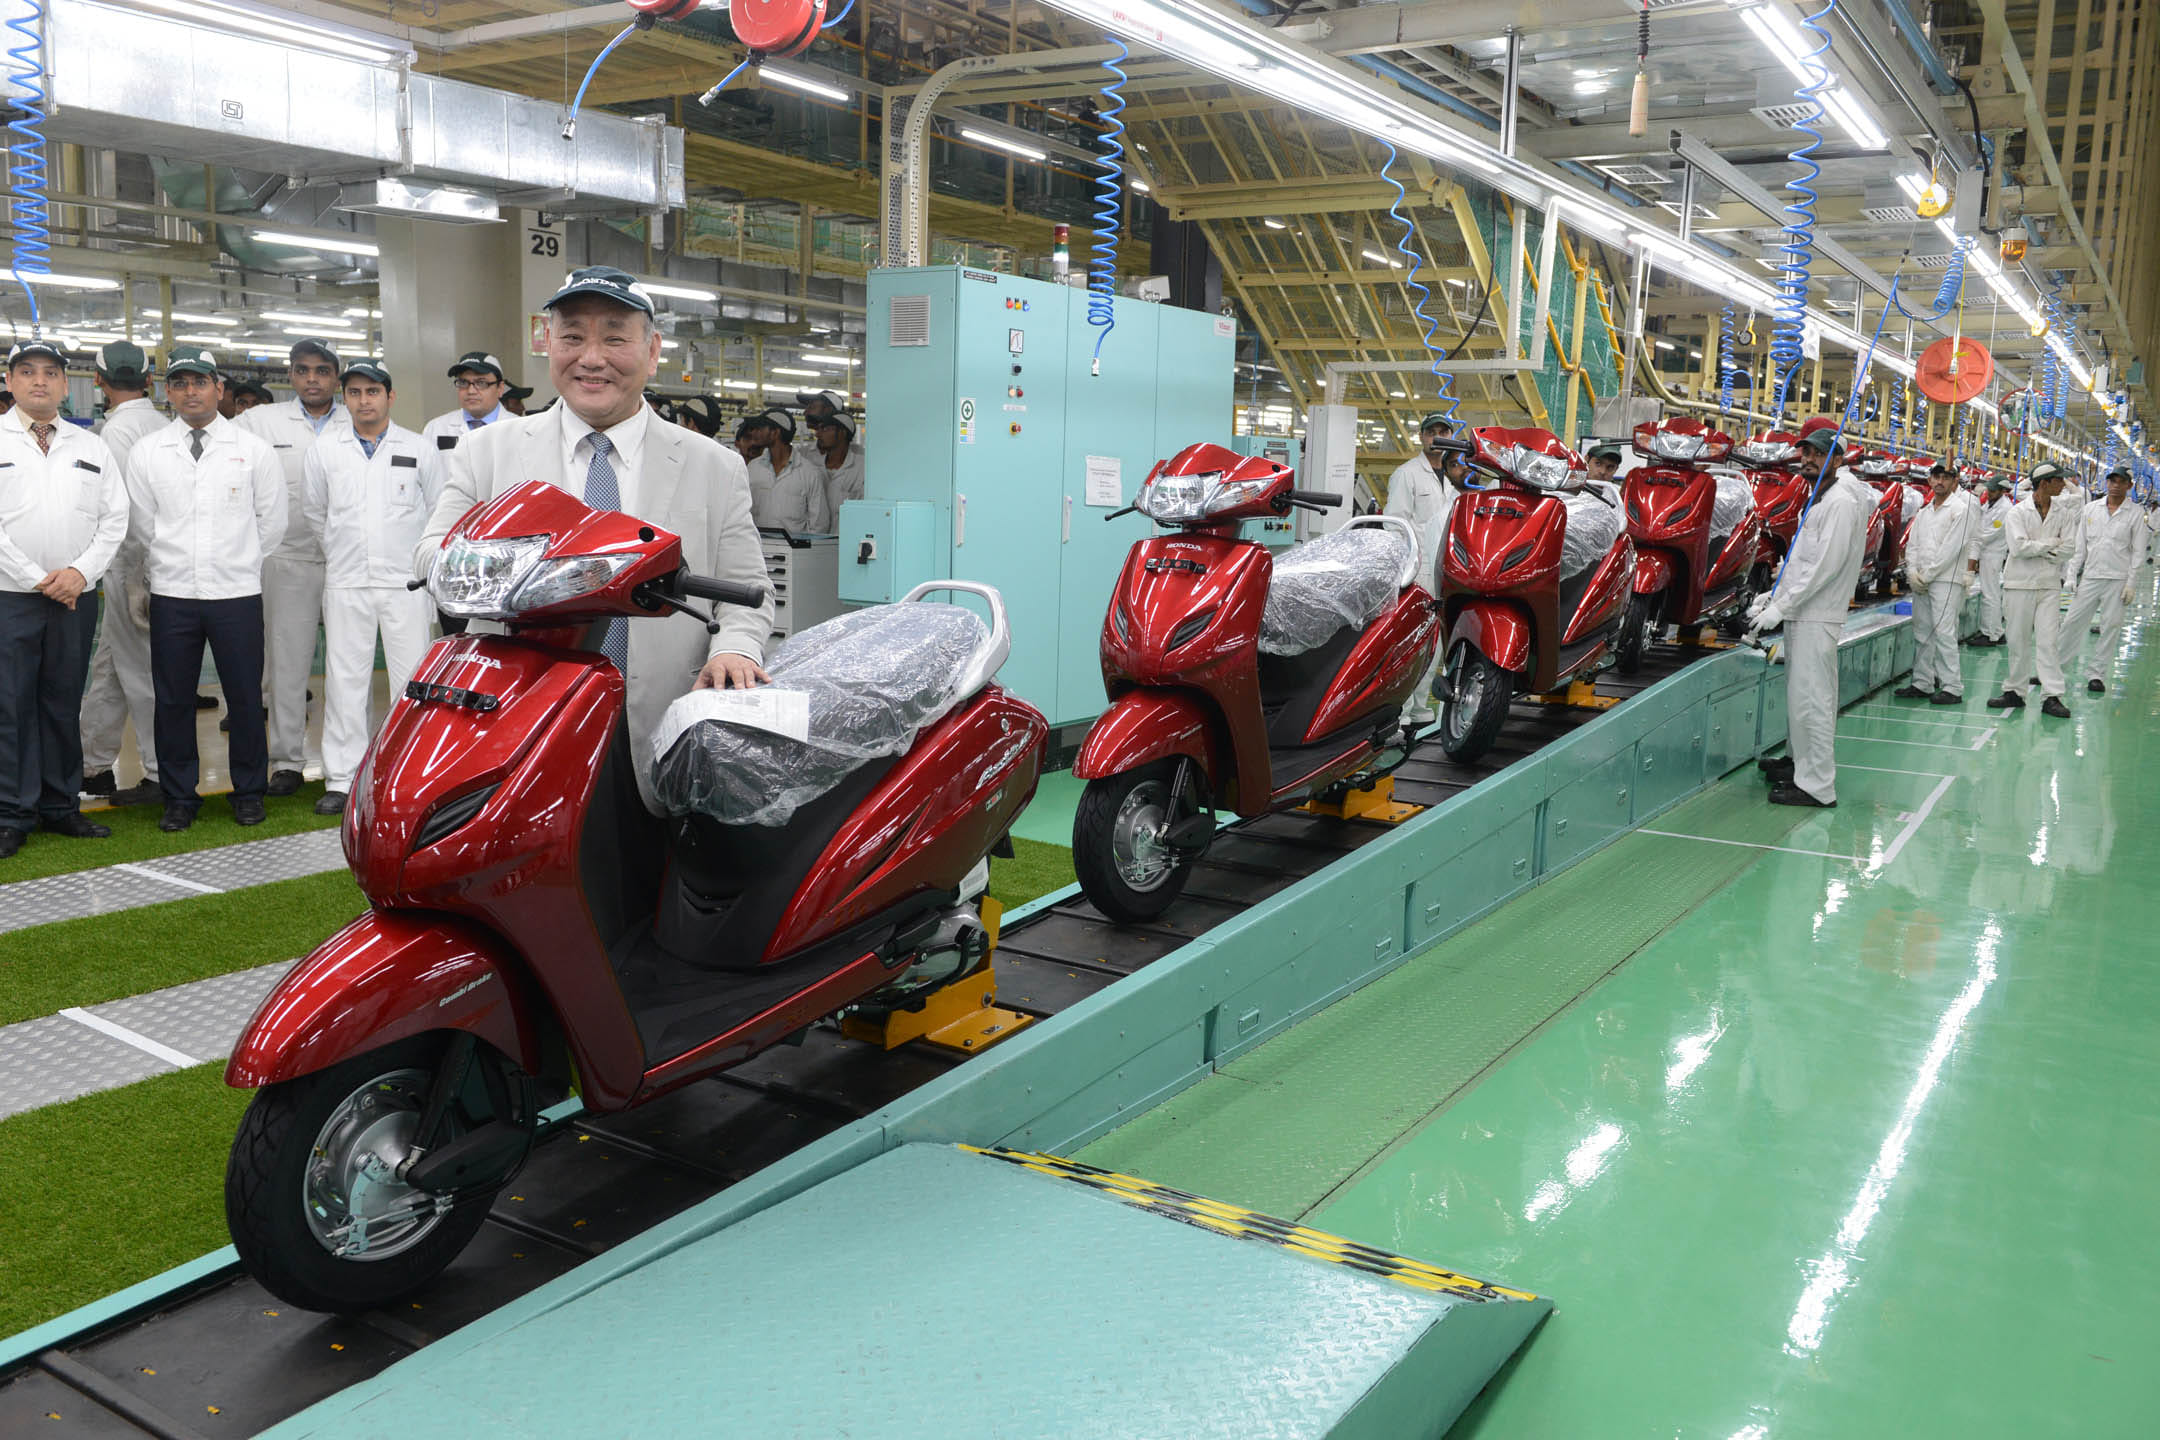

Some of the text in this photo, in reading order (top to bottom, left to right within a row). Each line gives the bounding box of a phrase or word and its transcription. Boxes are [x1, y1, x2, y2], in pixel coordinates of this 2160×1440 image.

[531, 234, 559, 257] 29
[1166, 542, 1202, 551] HONDA
[452, 652, 502, 669] HONDA
